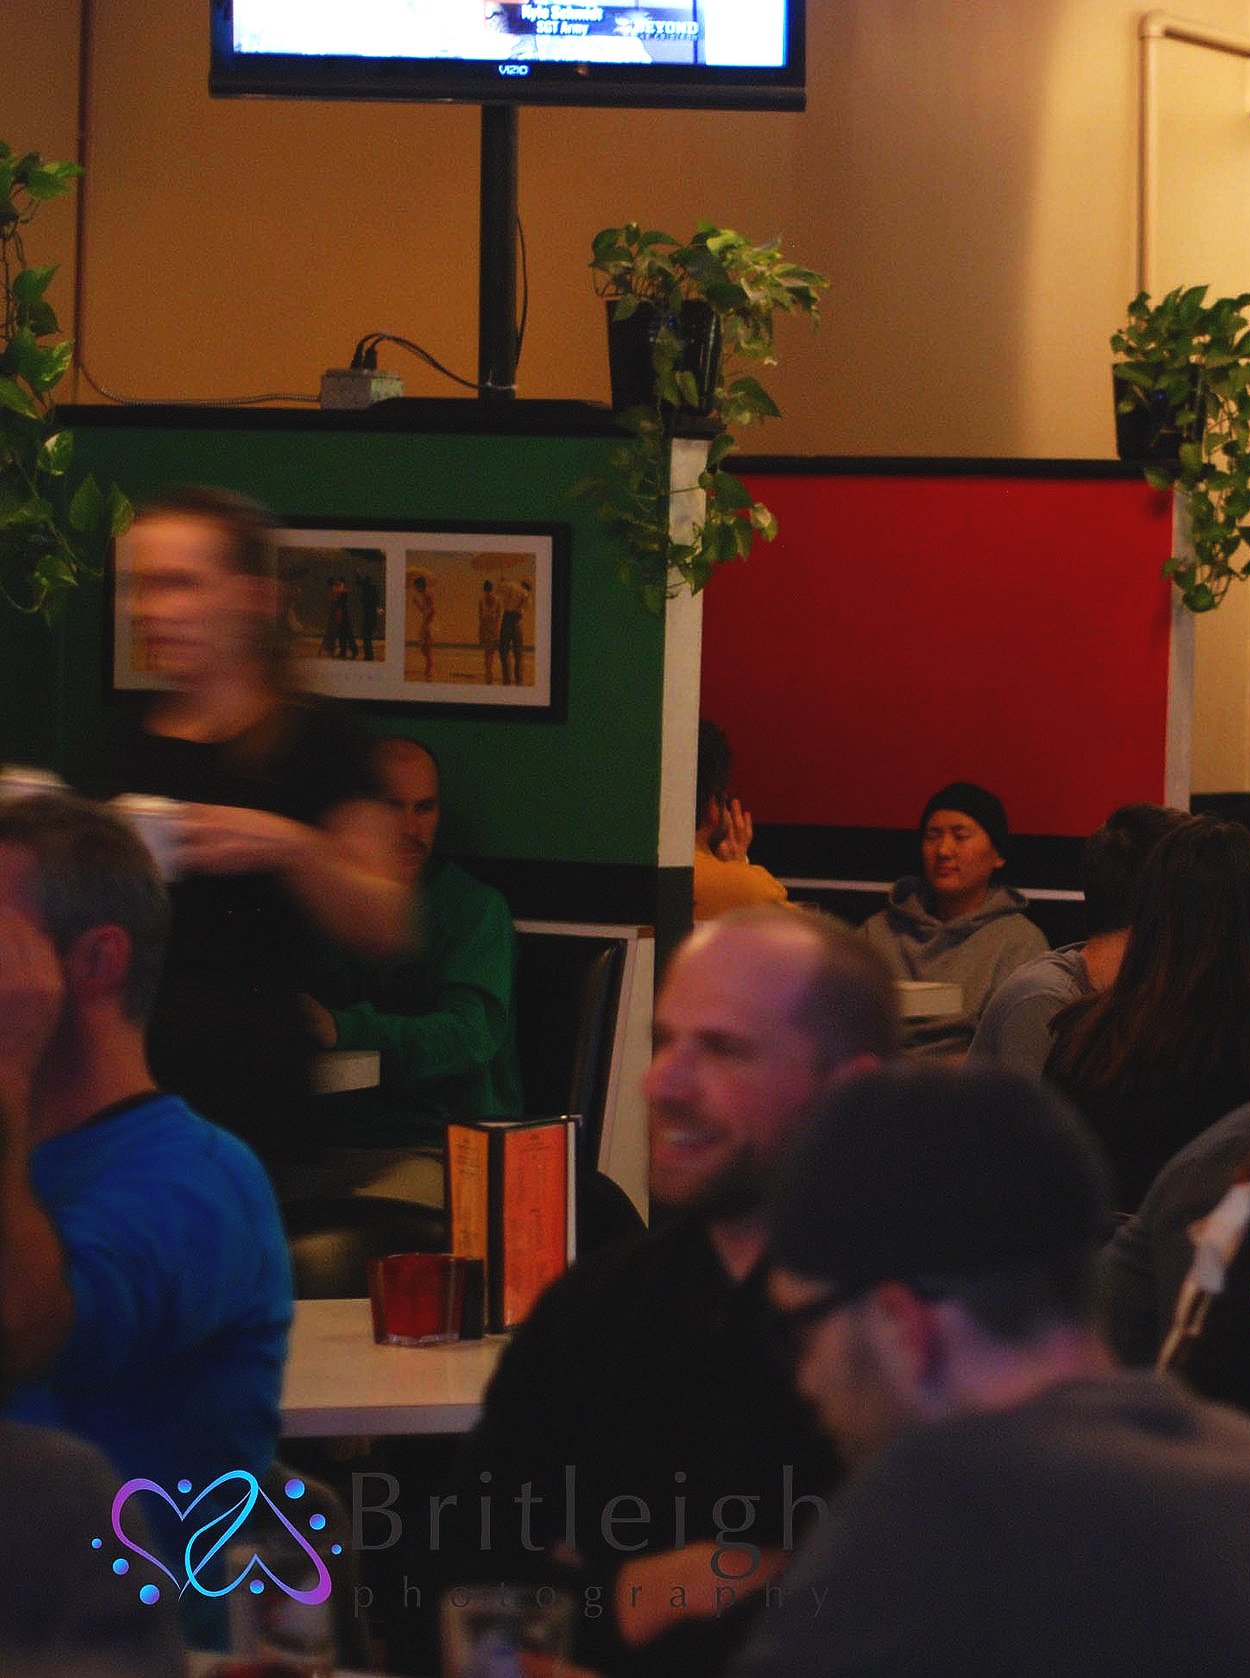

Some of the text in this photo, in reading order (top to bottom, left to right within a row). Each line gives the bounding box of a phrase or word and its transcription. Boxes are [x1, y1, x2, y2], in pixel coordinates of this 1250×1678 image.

[536, 20, 589, 36] SGT Army
[498, 64, 529, 75] VIZIO
